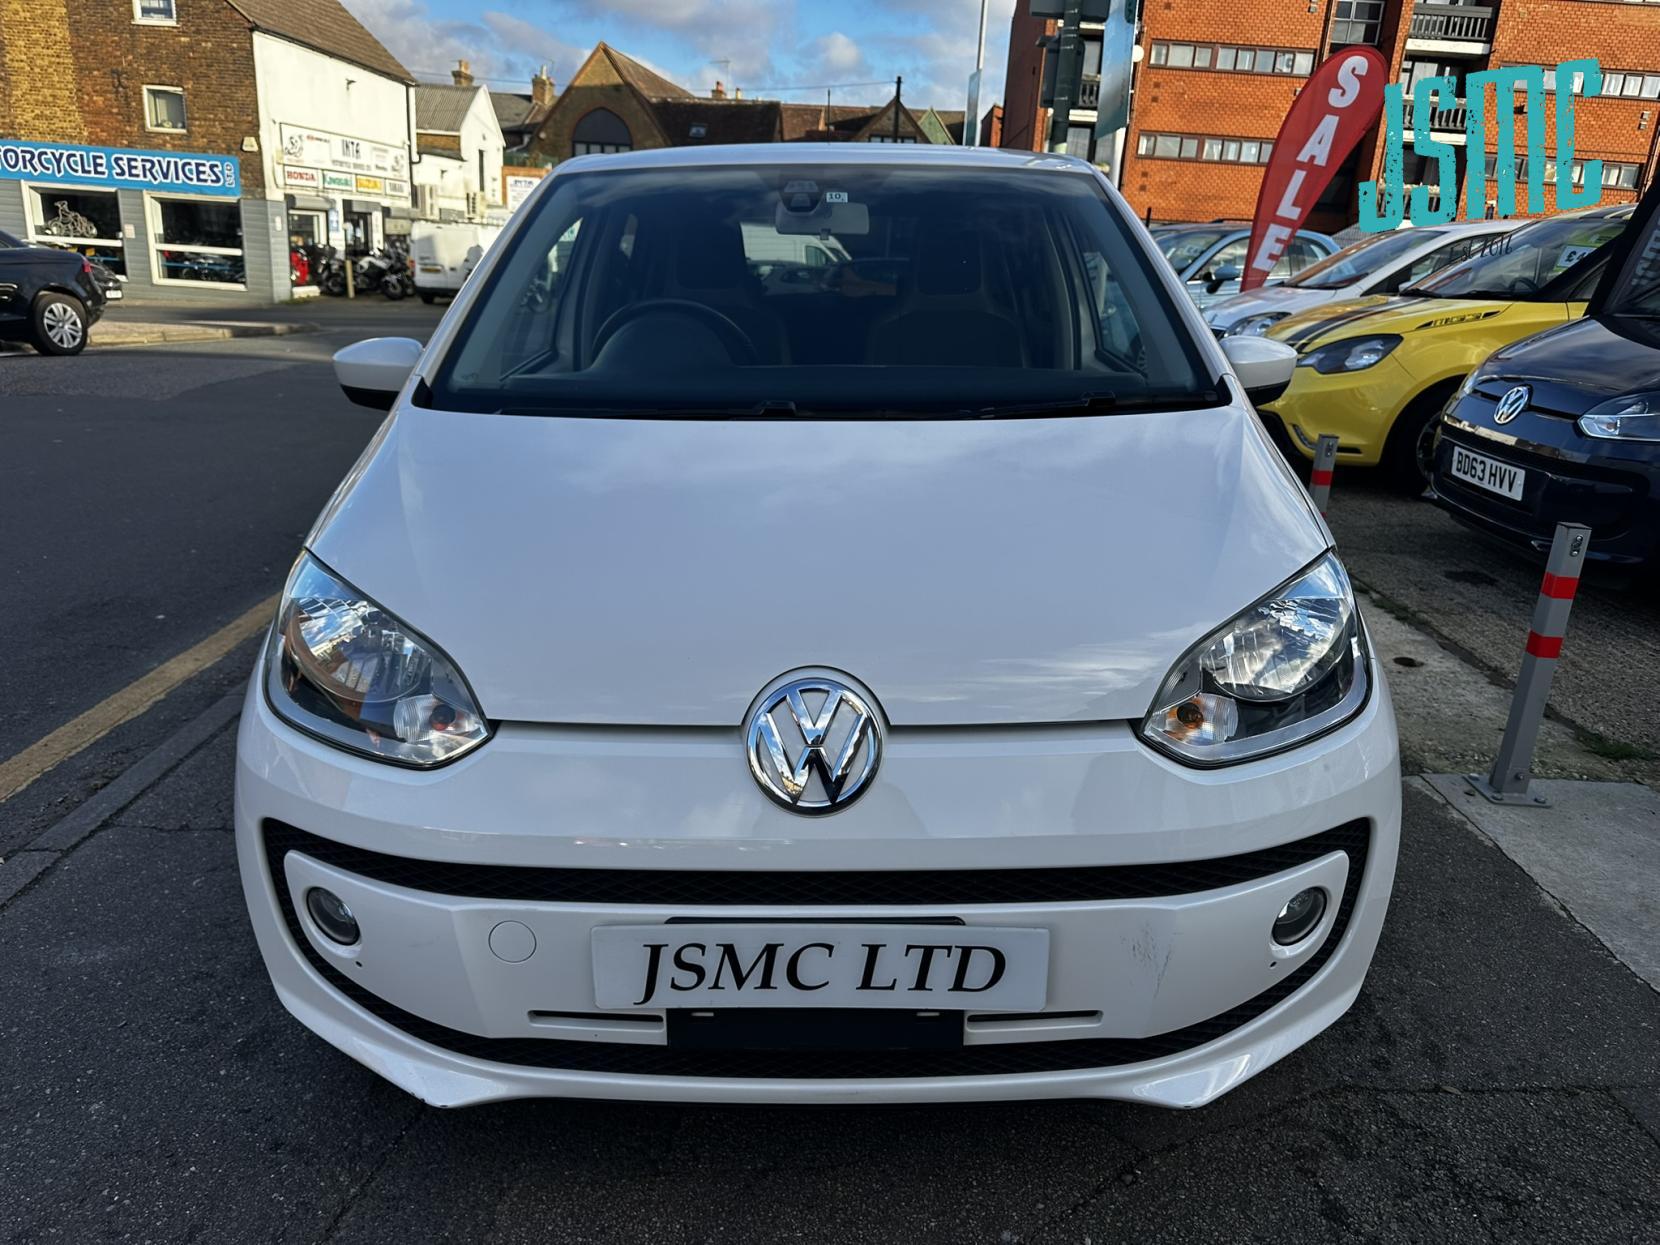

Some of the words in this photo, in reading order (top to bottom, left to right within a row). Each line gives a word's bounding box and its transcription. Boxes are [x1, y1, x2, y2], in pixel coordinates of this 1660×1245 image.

[0, 146, 107, 177] ORCYCLE
[112, 155, 223, 186] SERVICES
[286, 170, 316, 182] HONDA
[1252, 55, 1370, 273] SALE
[1456, 452, 1486, 482] BD63
[1488, 463, 1518, 493] HVV
[633, 942, 834, 1006] JSMC
[855, 943, 1007, 993] LTD
